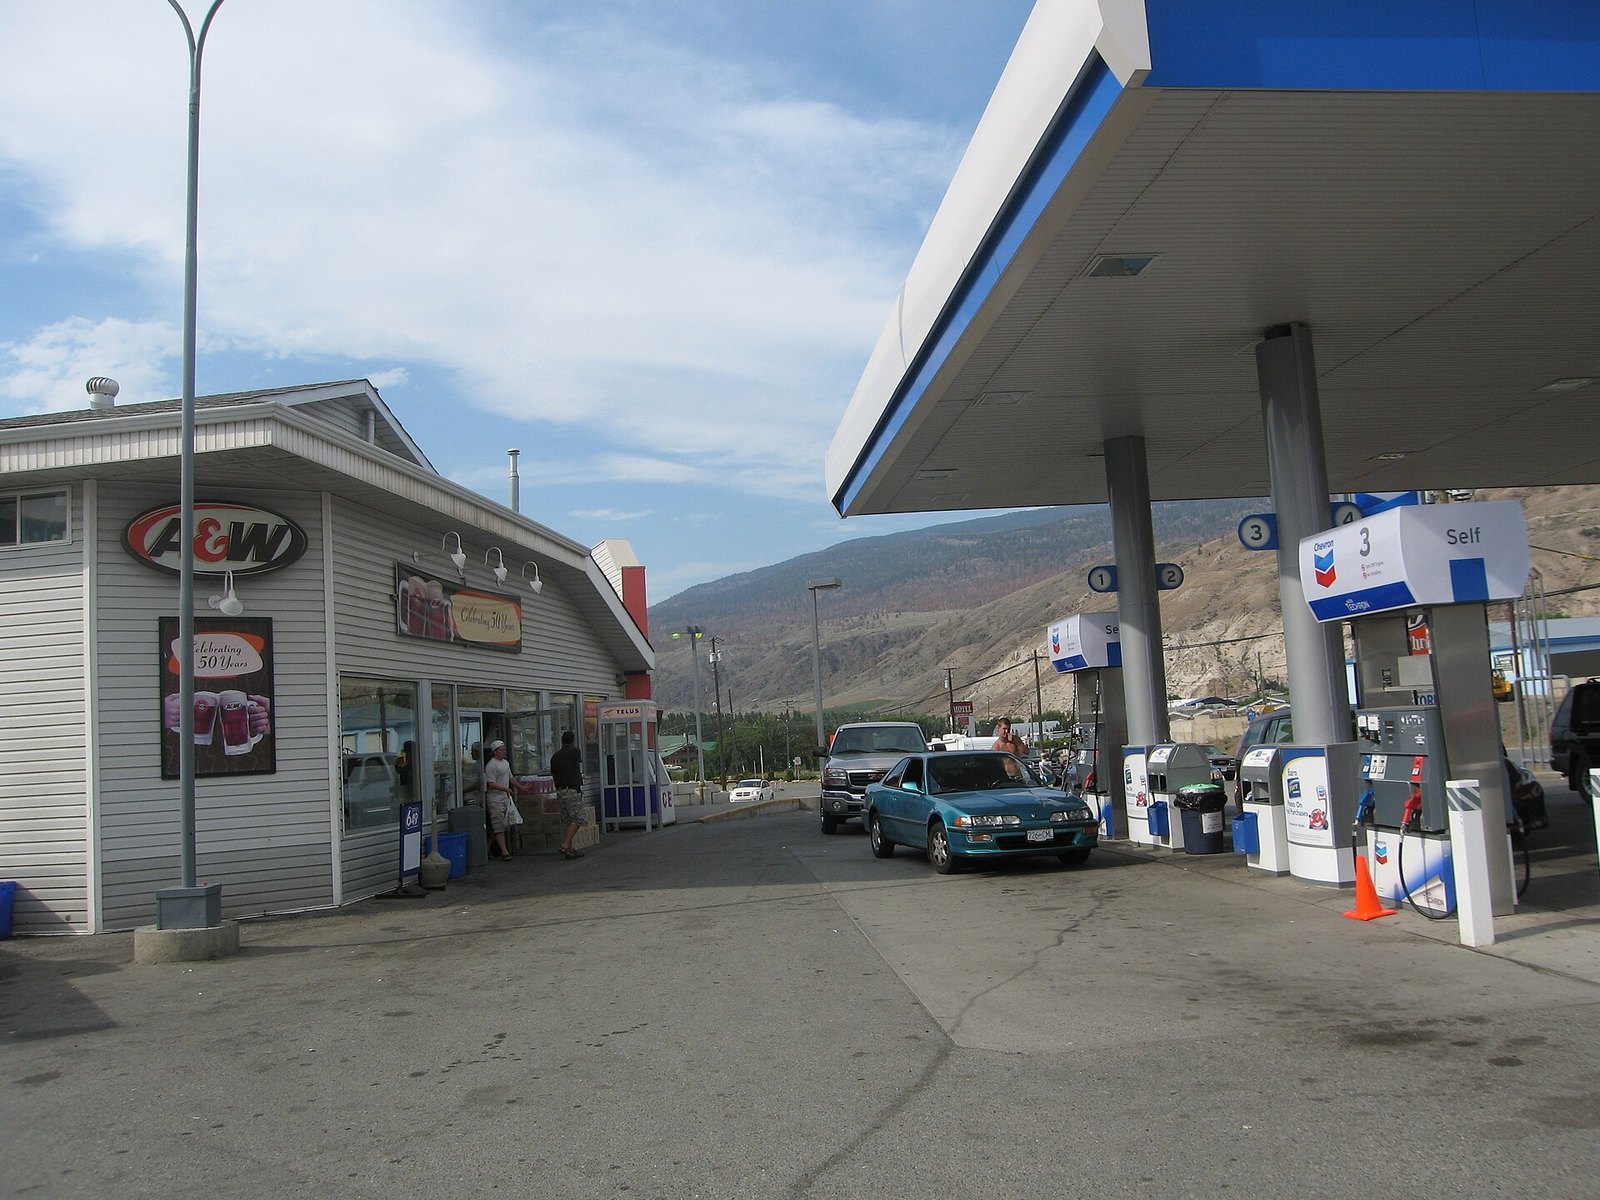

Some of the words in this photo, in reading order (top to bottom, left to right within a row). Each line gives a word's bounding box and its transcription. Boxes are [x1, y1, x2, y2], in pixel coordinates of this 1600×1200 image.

[148, 516, 289, 563] A&W
[1250, 524, 1263, 541] 3
[1446, 526, 1481, 545] Self
[1313, 539, 1334, 552] Chevron
[1359, 526, 1371, 557] 3
[1098, 573, 1104, 586] 1
[1166, 570, 1177, 583] 2
[460, 605, 490, 631] Celebrating
[1105, 625, 1120, 635] Se
[194, 640, 241, 655] elebrating
[197, 655, 218, 669] 50
[219, 655, 248, 671] Years
[662, 791, 673, 809] CE
